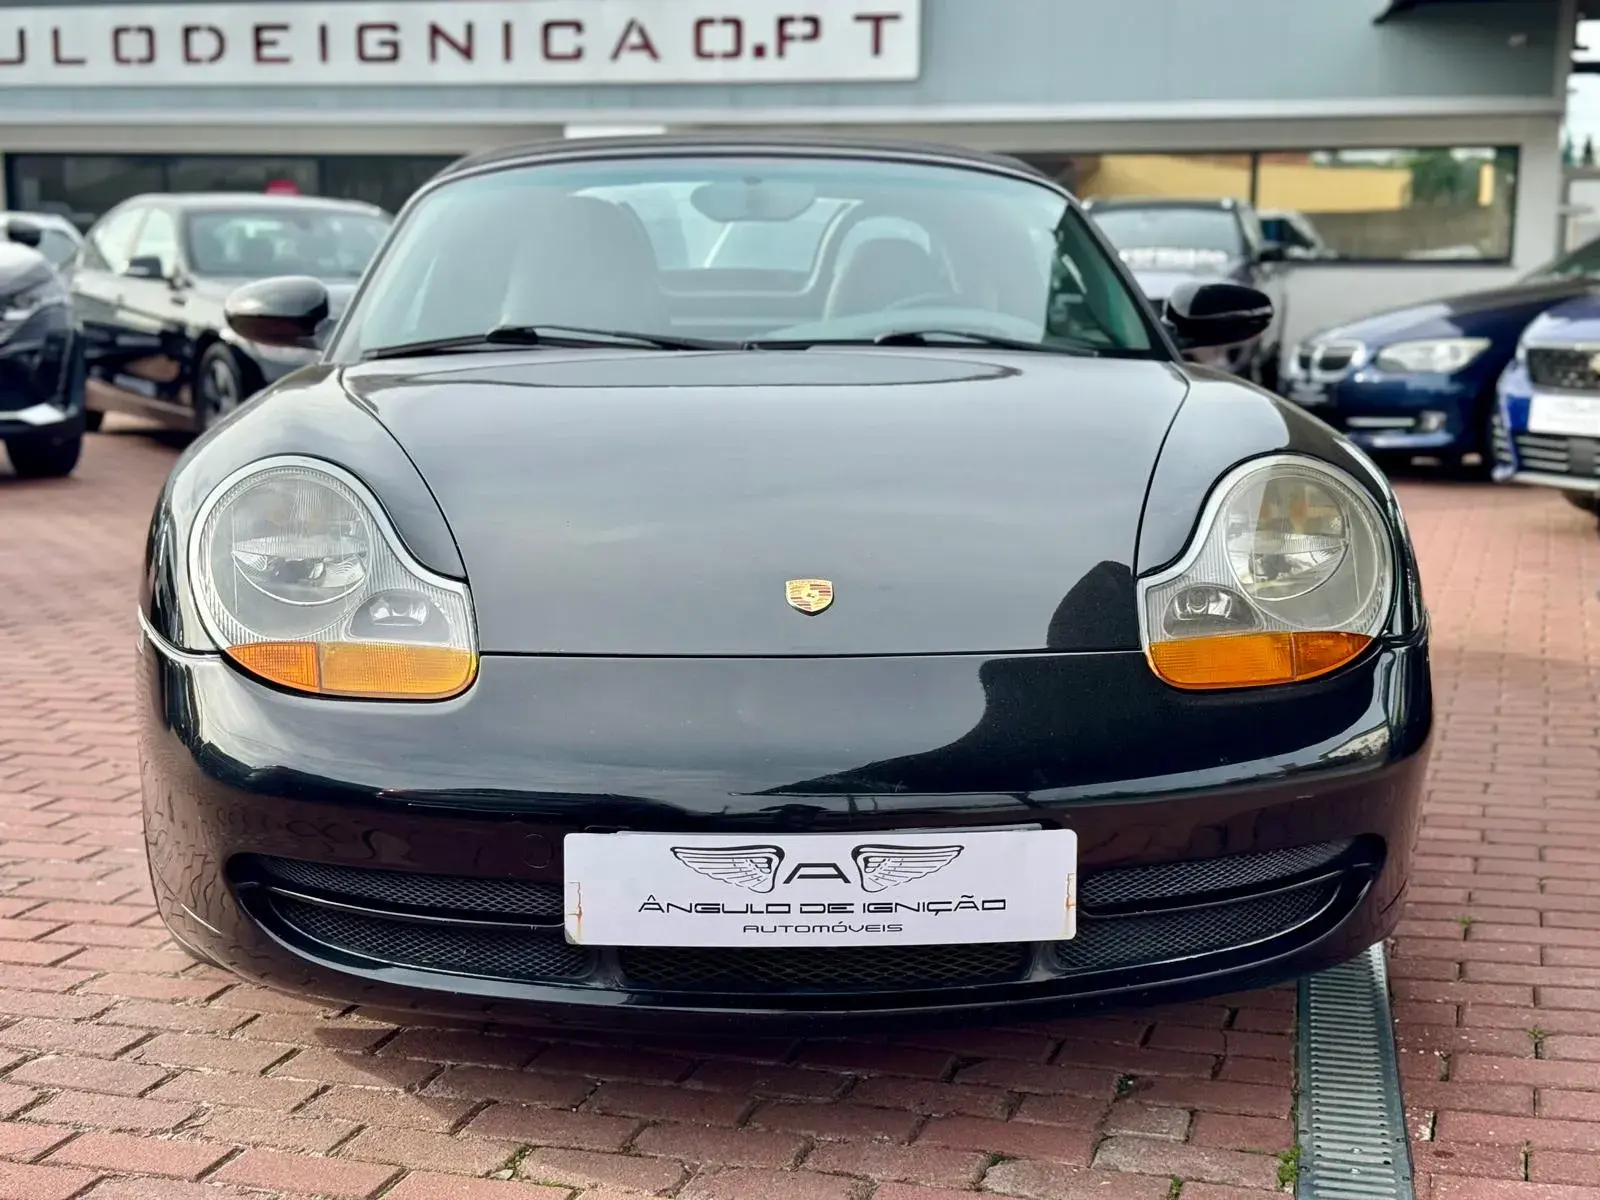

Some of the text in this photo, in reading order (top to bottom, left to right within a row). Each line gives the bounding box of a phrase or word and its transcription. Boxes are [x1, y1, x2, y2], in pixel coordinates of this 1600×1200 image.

[782, 862, 852, 884] A
[638, 894, 1007, 917] ÂNGULO DE IGNIÇÃO
[742, 921, 904, 934] AUTOMÓVEIS
